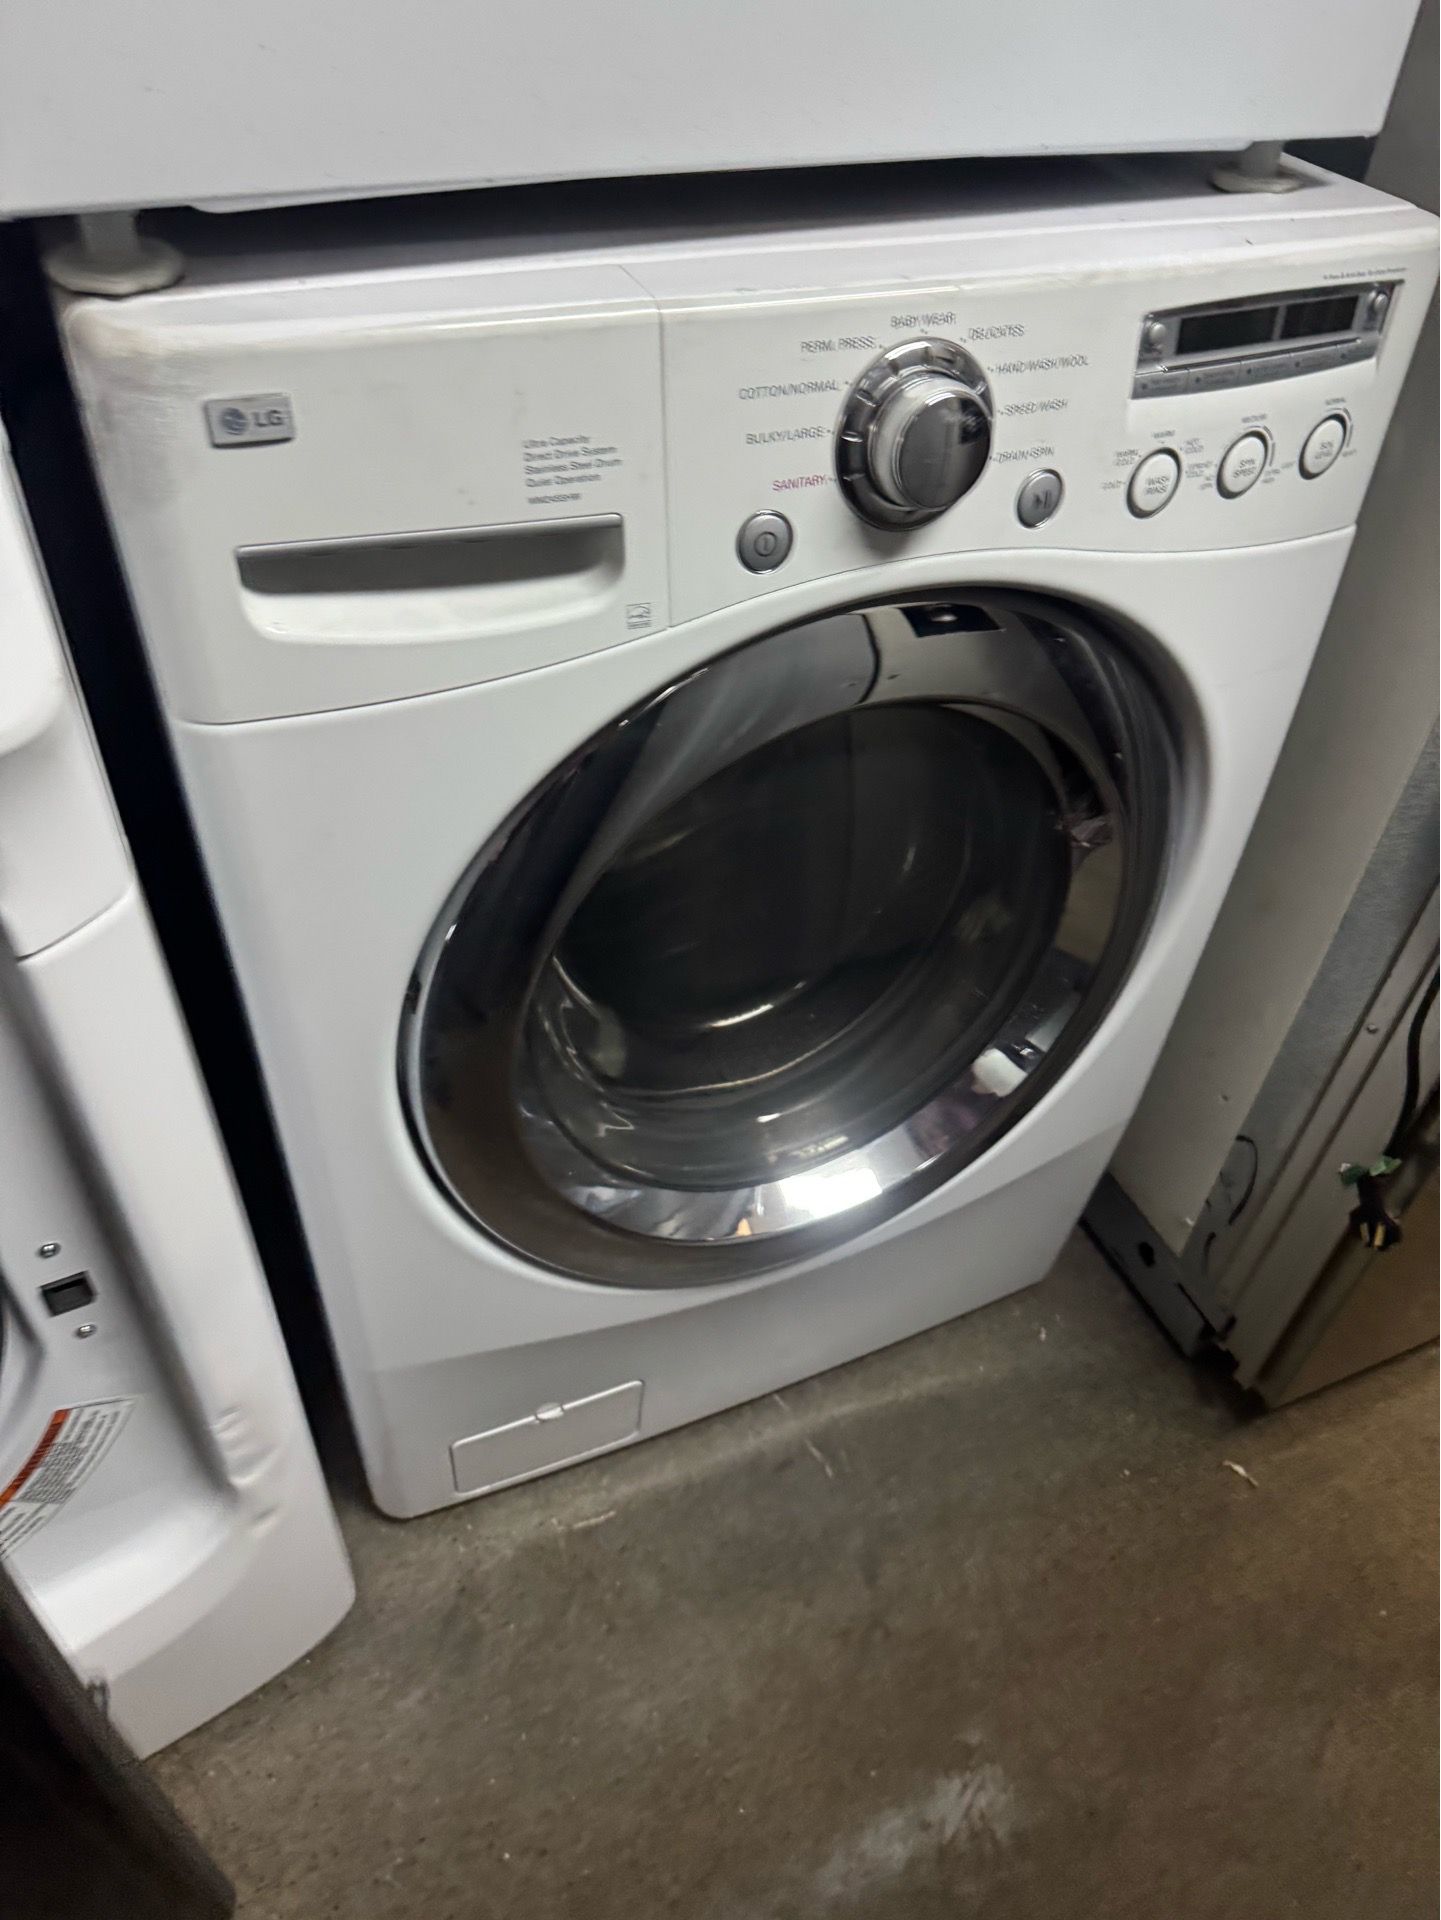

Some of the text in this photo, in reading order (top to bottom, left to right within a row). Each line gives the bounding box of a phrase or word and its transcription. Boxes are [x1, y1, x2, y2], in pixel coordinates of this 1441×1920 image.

[738, 379, 842, 400] COTTON/NORMAL
[252, 407, 284, 428] LG
[744, 426, 824, 445] BULKY/LARGE
[771, 474, 827, 492] SANITARY
